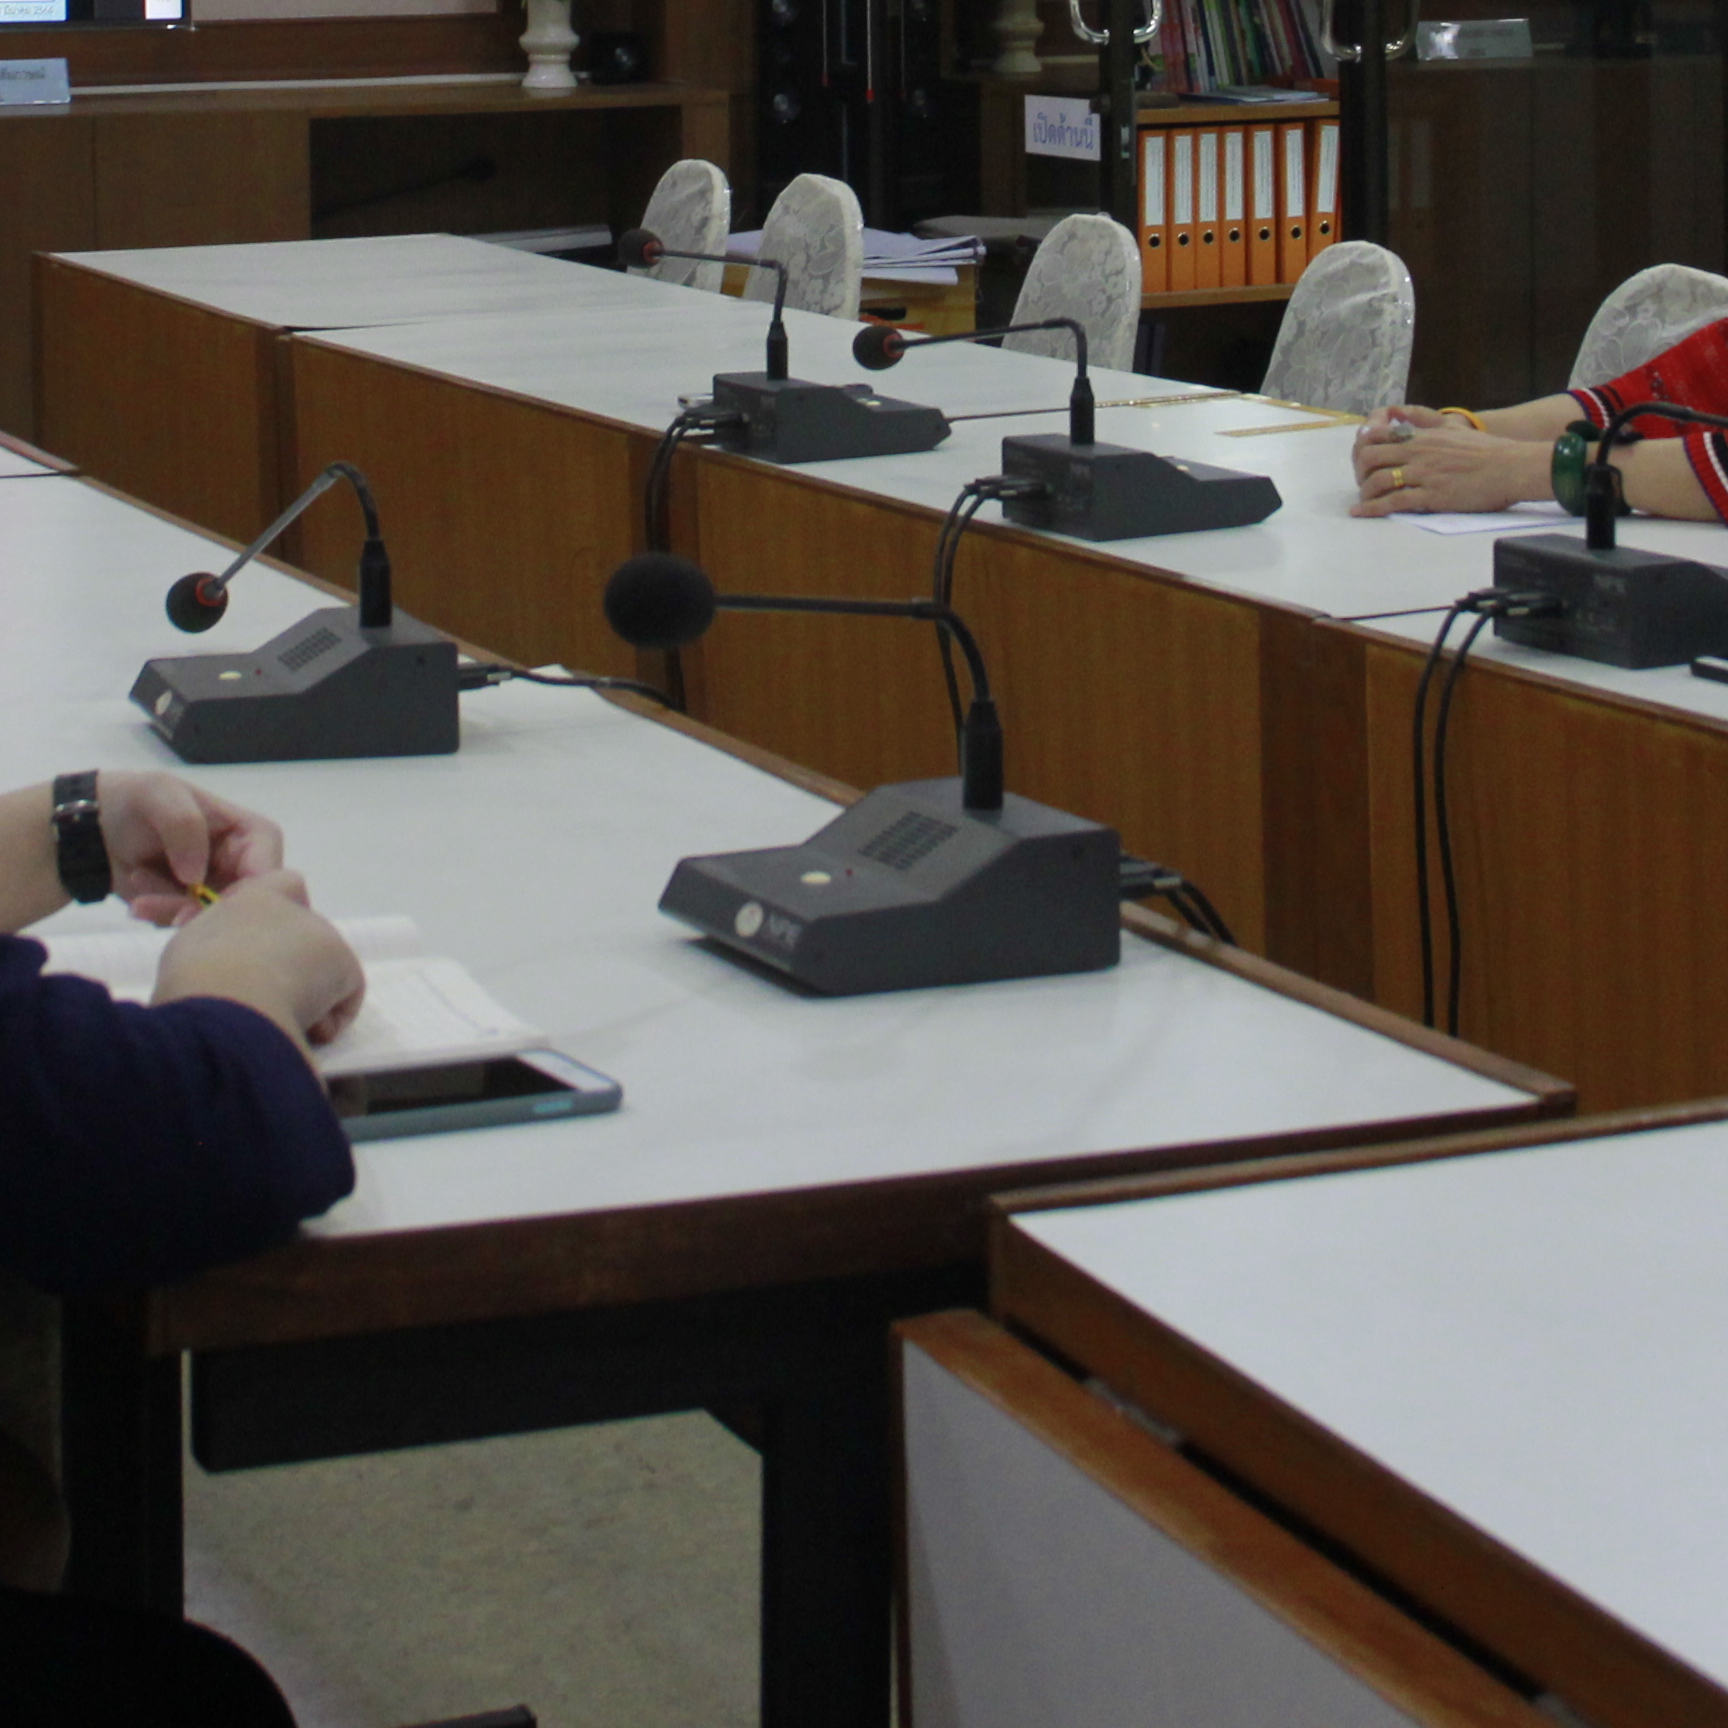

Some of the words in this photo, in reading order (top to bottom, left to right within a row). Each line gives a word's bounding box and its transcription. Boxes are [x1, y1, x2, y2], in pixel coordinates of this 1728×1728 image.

[1032, 111, 1095, 150] เปิดด้านนี้
